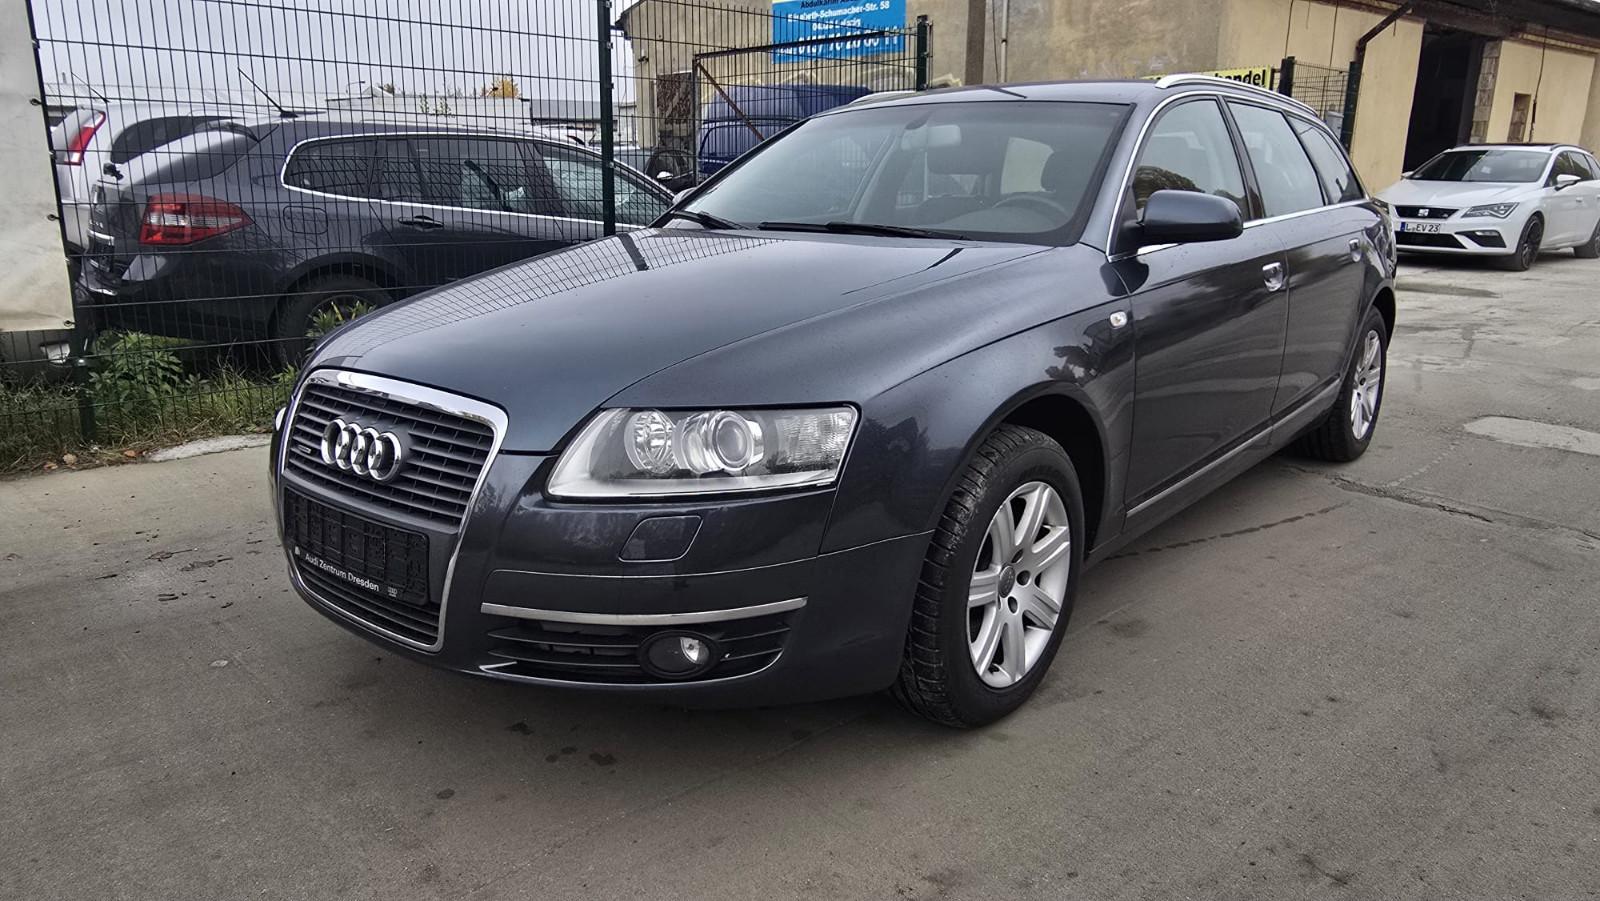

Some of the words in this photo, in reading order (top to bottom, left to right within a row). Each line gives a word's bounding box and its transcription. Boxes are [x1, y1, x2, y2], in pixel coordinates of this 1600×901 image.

[1215, 69, 1266, 86] ndel
[1416, 224, 1427, 232] EV
[1428, 224, 1439, 233] 23
[305, 553, 319, 566] Audi
[319, 559, 347, 579] Zentrum
[347, 572, 380, 592] Dresden
